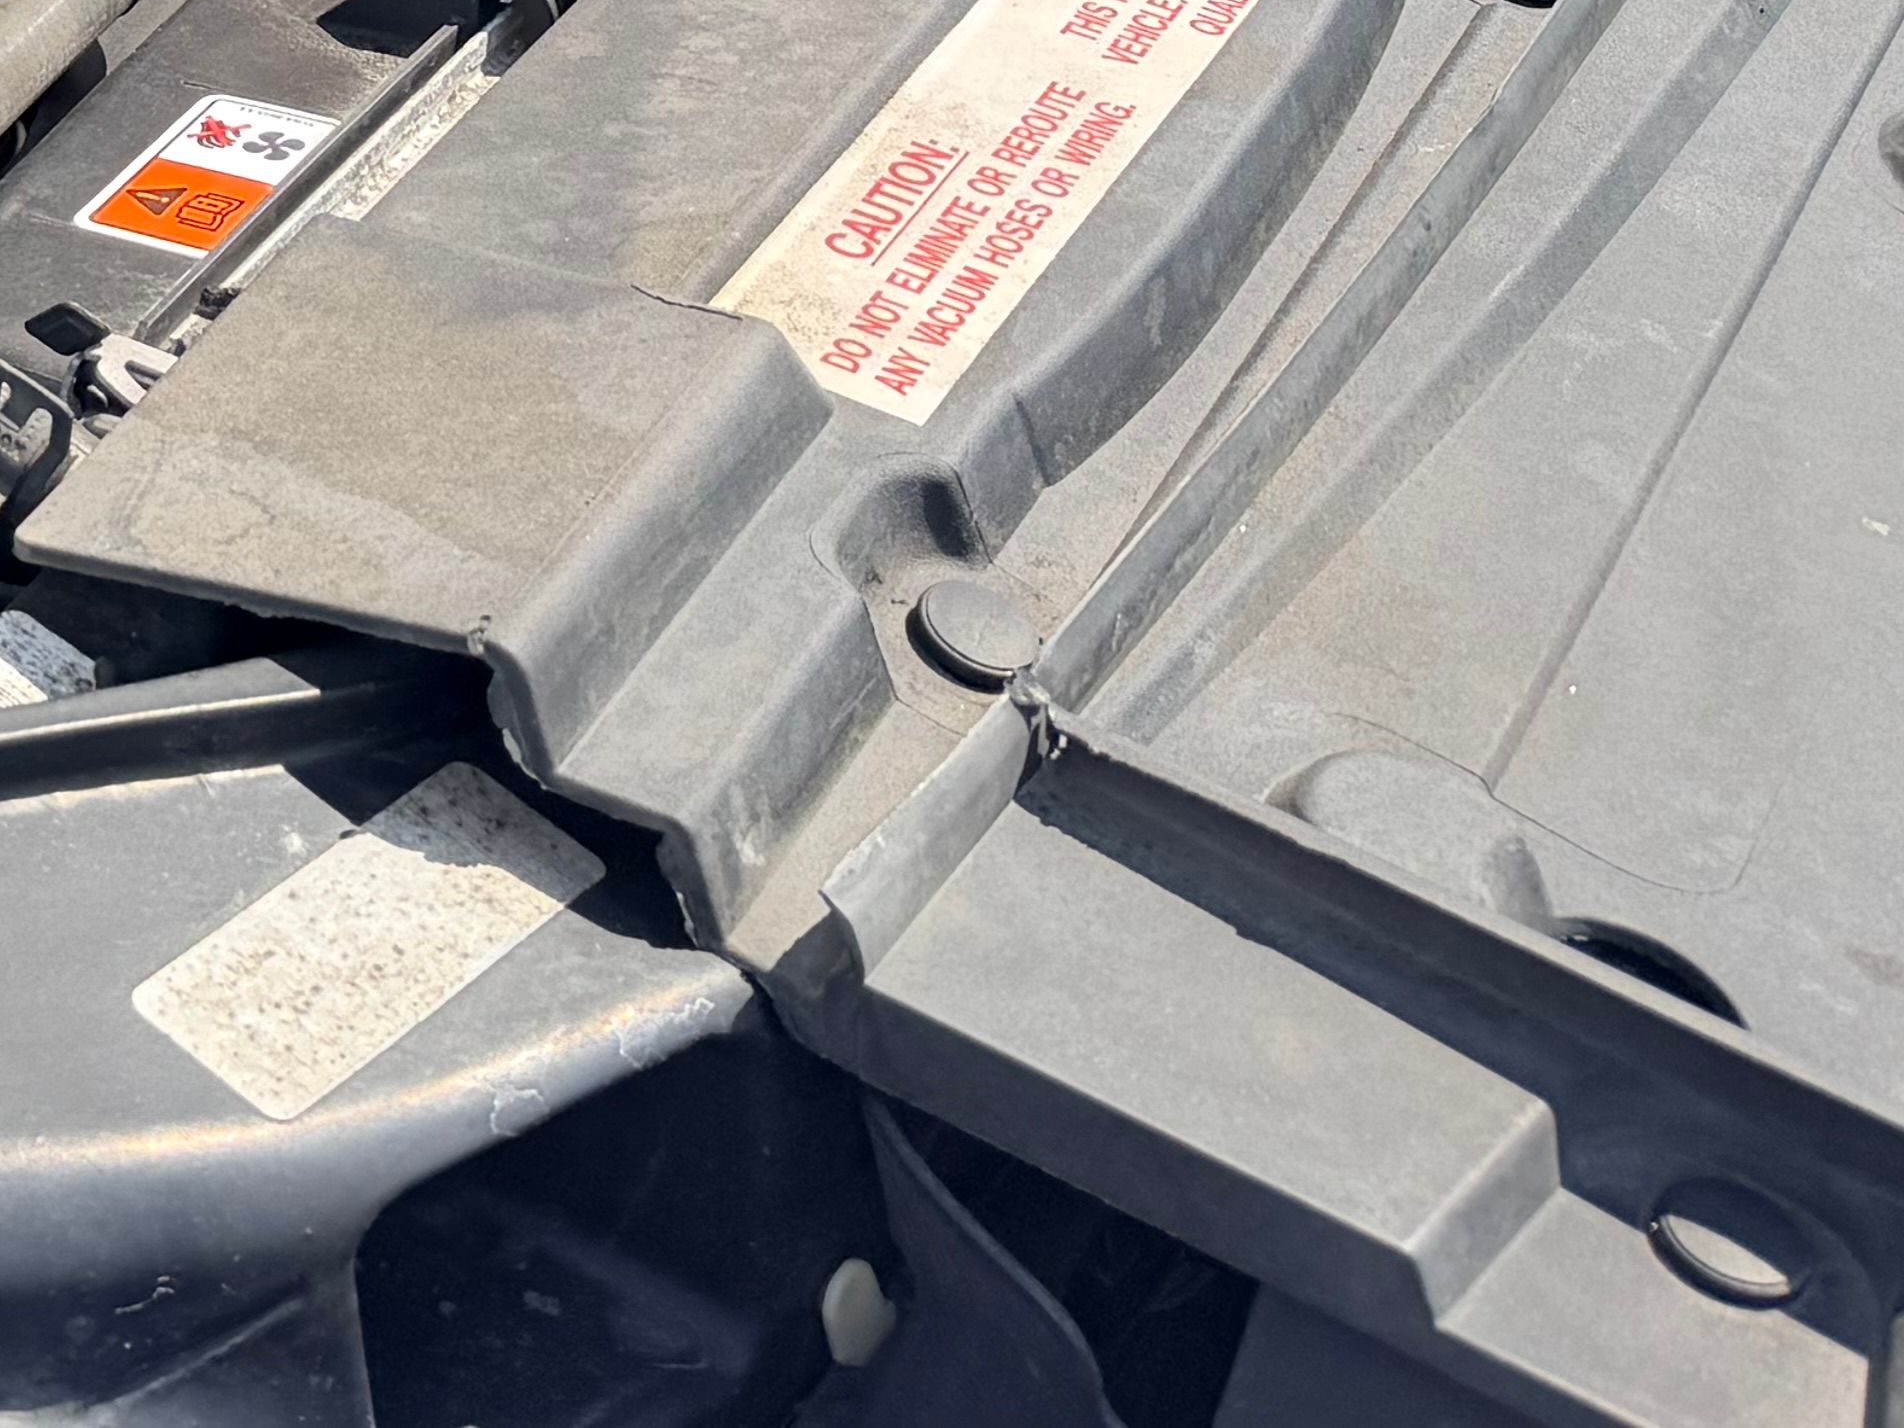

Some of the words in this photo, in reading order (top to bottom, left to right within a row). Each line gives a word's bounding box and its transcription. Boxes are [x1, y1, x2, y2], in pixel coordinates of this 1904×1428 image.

[990, 78, 1087, 170] REROUTE
[1053, 92, 1138, 172] WIRING.
[820, 129, 961, 267] CAUTION:
[965, 160, 1018, 201] OR
[1028, 162, 1081, 202] OR
[885, 192, 992, 297] ELIMINATE
[973, 194, 1055, 271] HOSES
[848, 289, 910, 343] NOT
[906, 261, 1000, 355] VACUUM
[819, 331, 874, 378] DO
[873, 345, 931, 396] ANY
